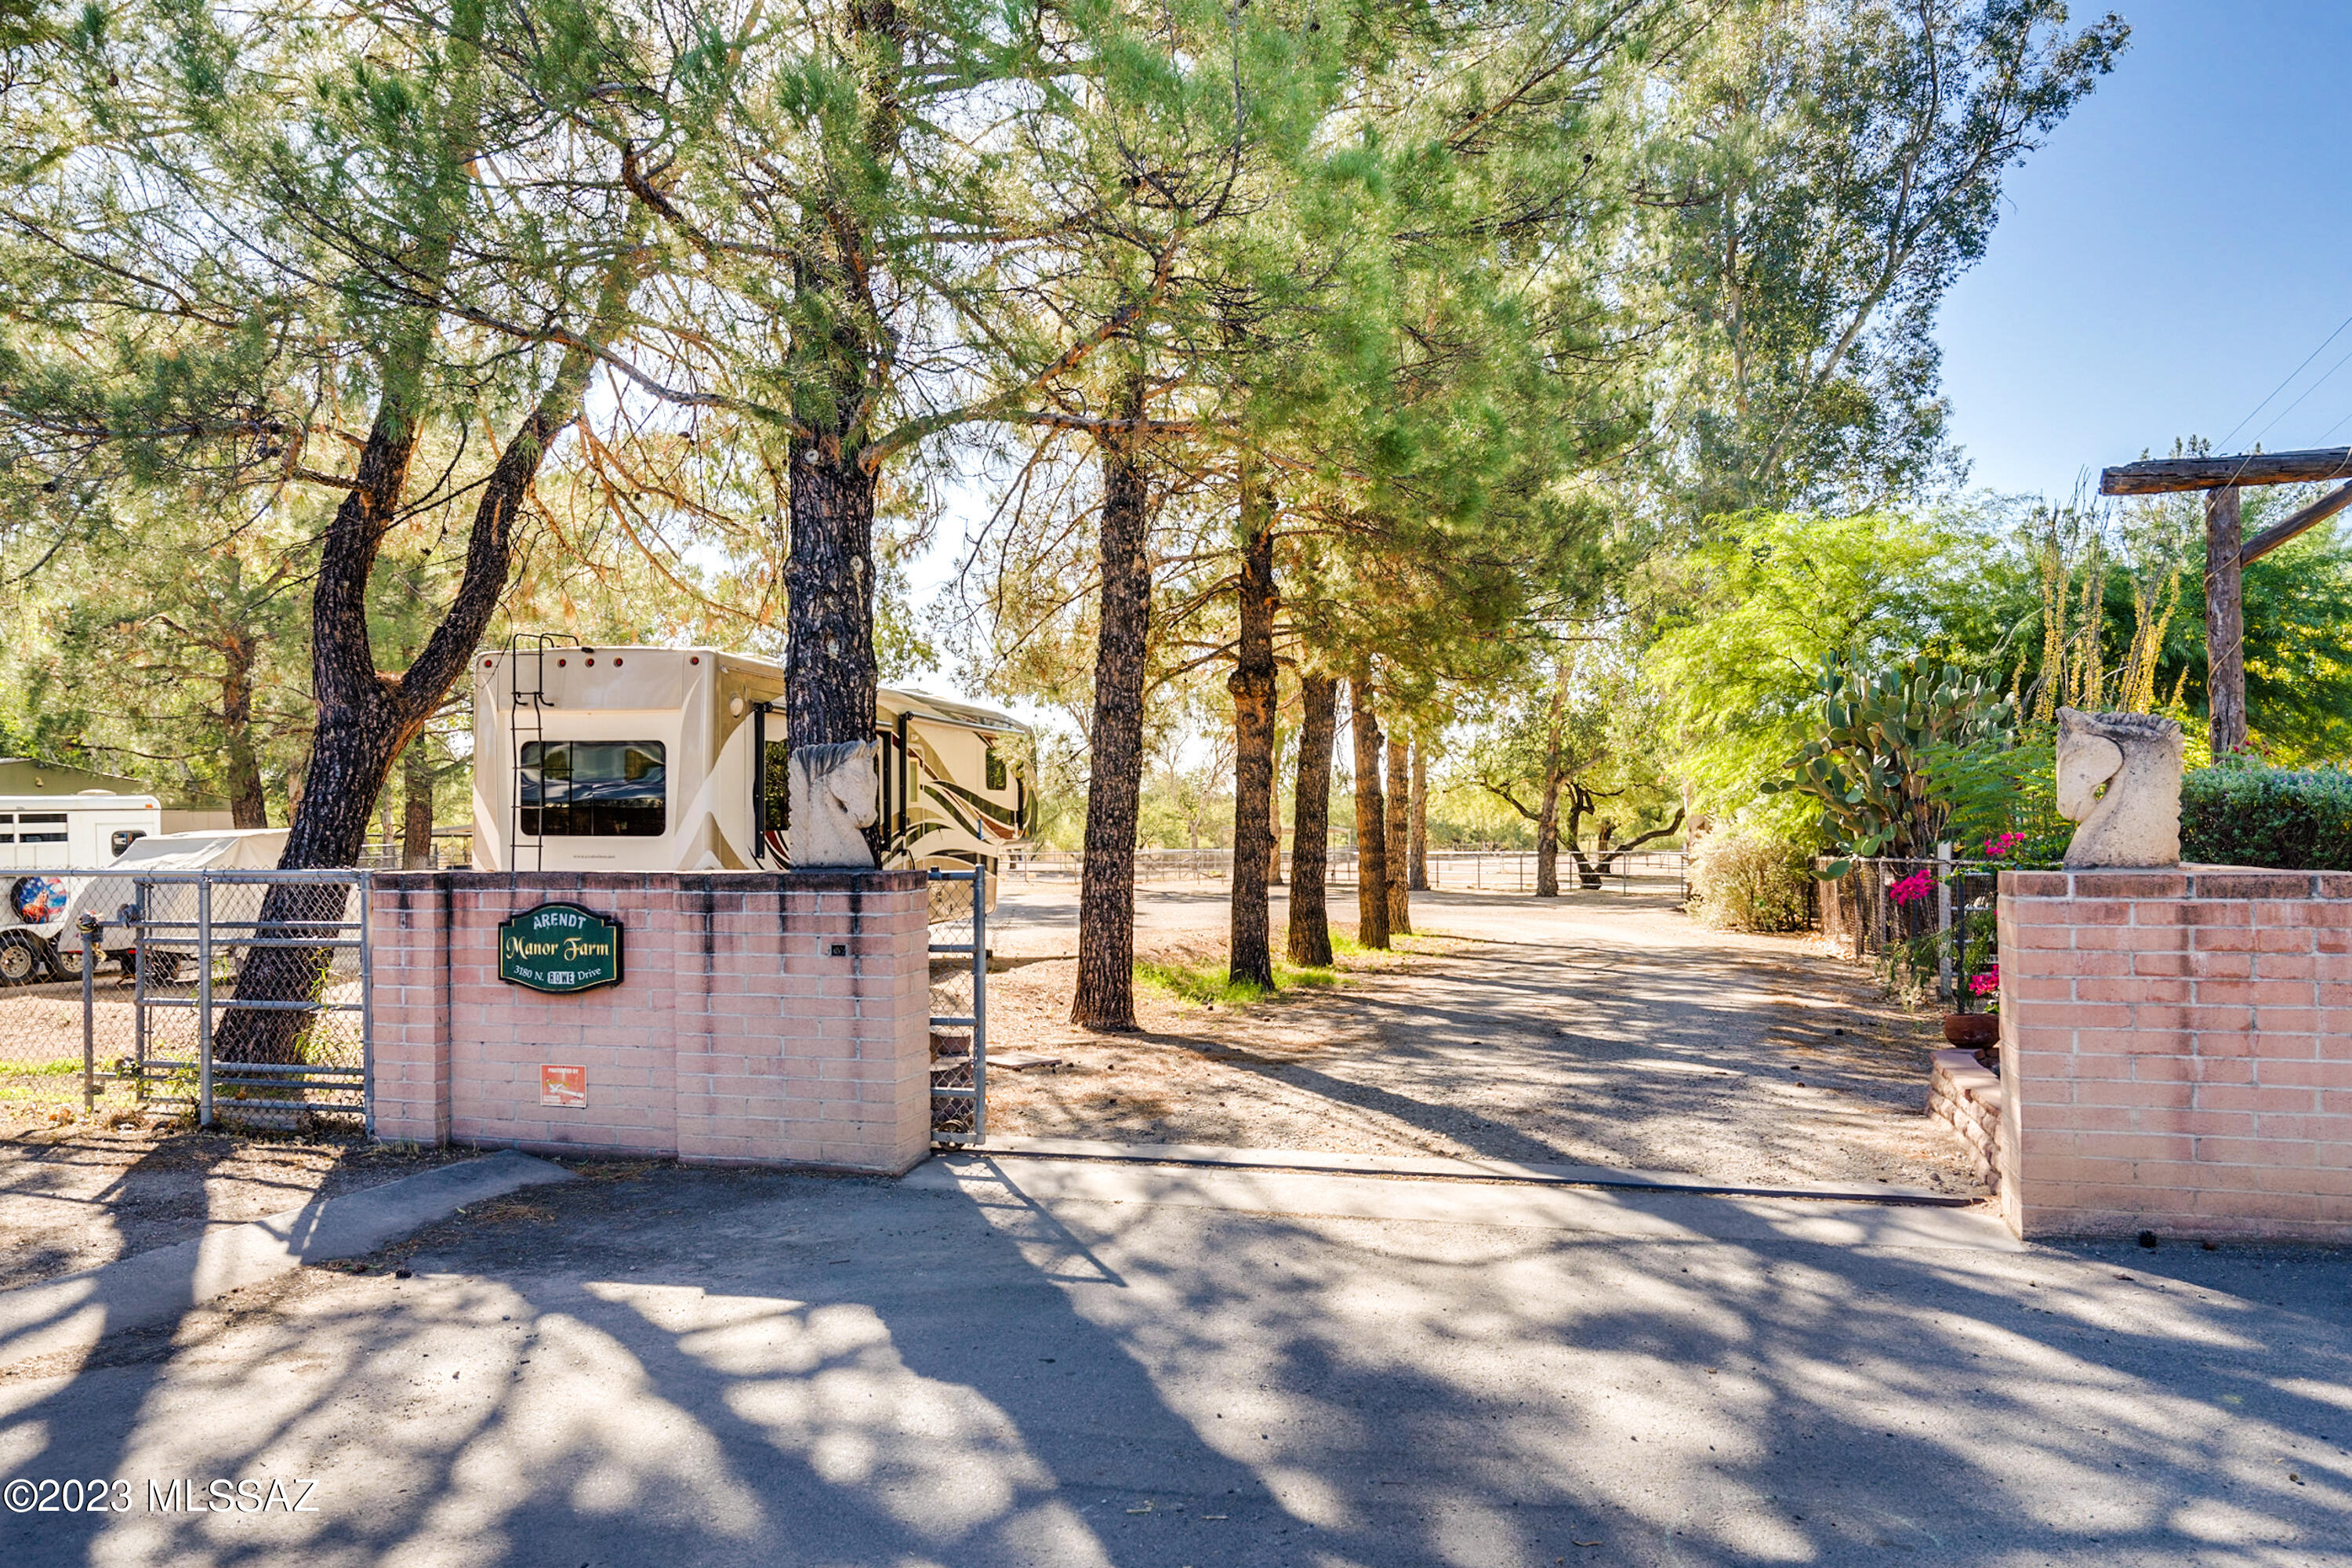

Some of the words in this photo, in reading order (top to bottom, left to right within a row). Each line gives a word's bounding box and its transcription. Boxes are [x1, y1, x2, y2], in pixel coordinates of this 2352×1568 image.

[533, 913, 586, 930] ARENDT
[506, 936, 559, 960] Manor
[563, 937, 609, 961] Farm
[514, 965, 533, 978] 3180
[534, 971, 544, 982] N.
[578, 967, 602, 981] Drive
